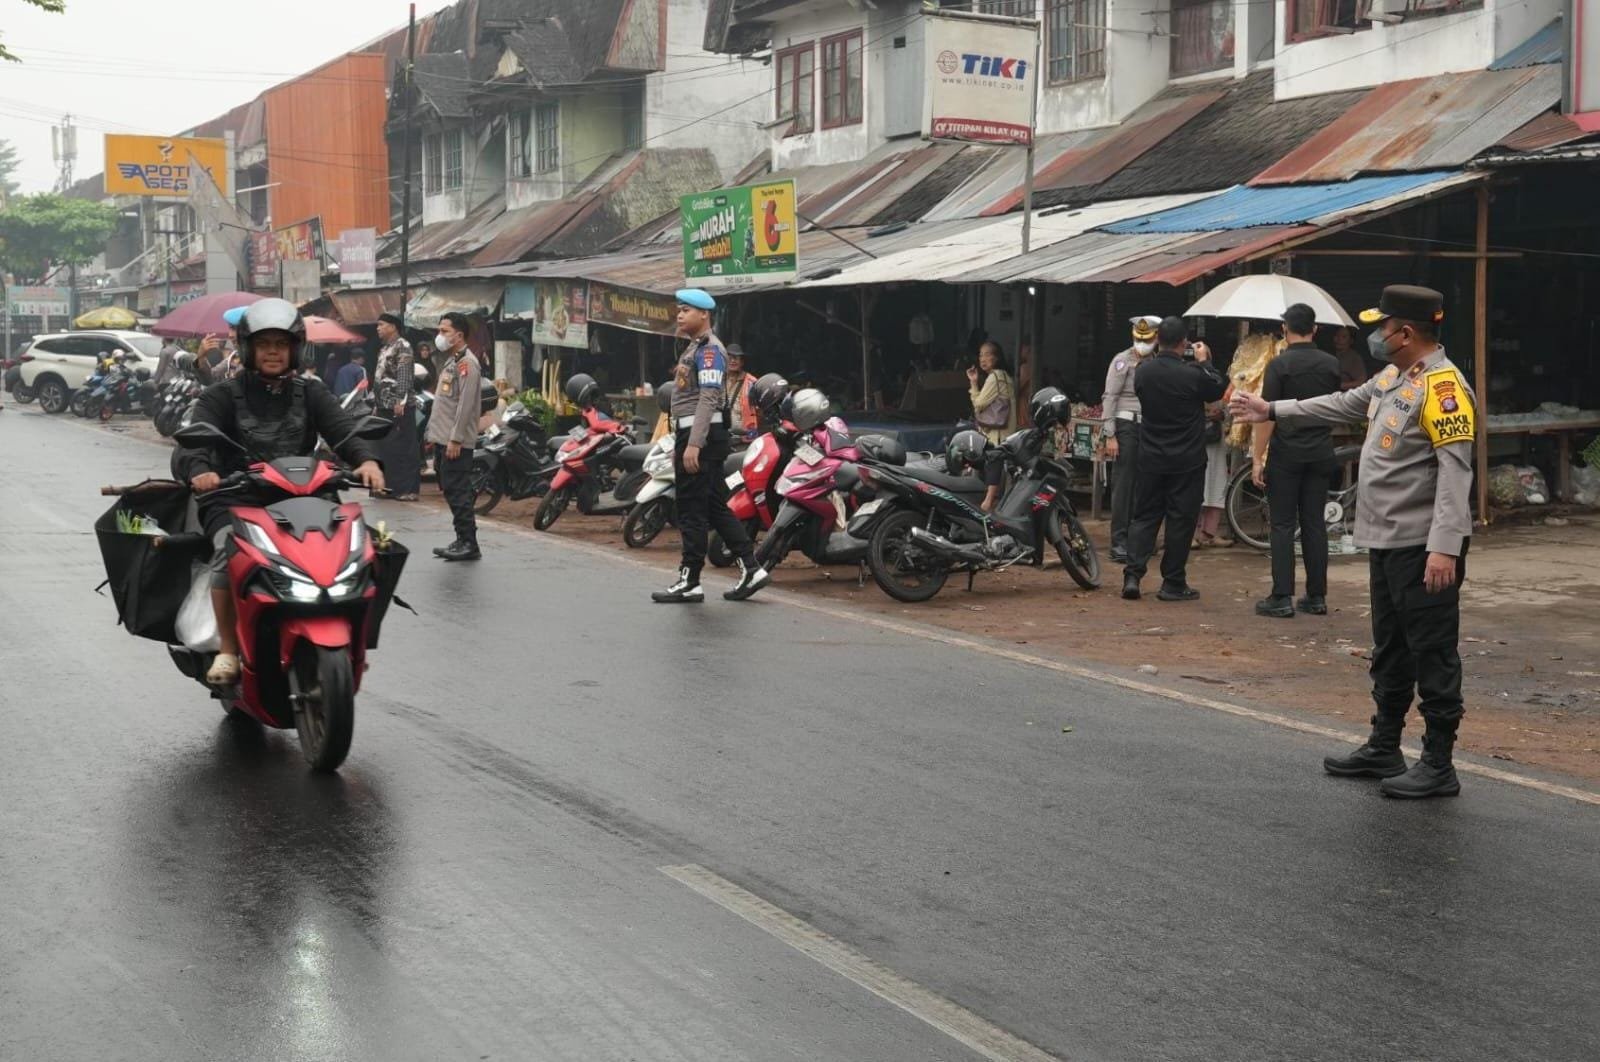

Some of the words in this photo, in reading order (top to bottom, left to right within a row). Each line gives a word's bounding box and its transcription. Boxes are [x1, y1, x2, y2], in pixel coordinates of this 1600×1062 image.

[700, 206, 735, 242] MURAH
[1393, 398, 1411, 413] POLRI
[1432, 415, 1471, 430] WAKIL
[1438, 424, 1470, 439] PJKO
